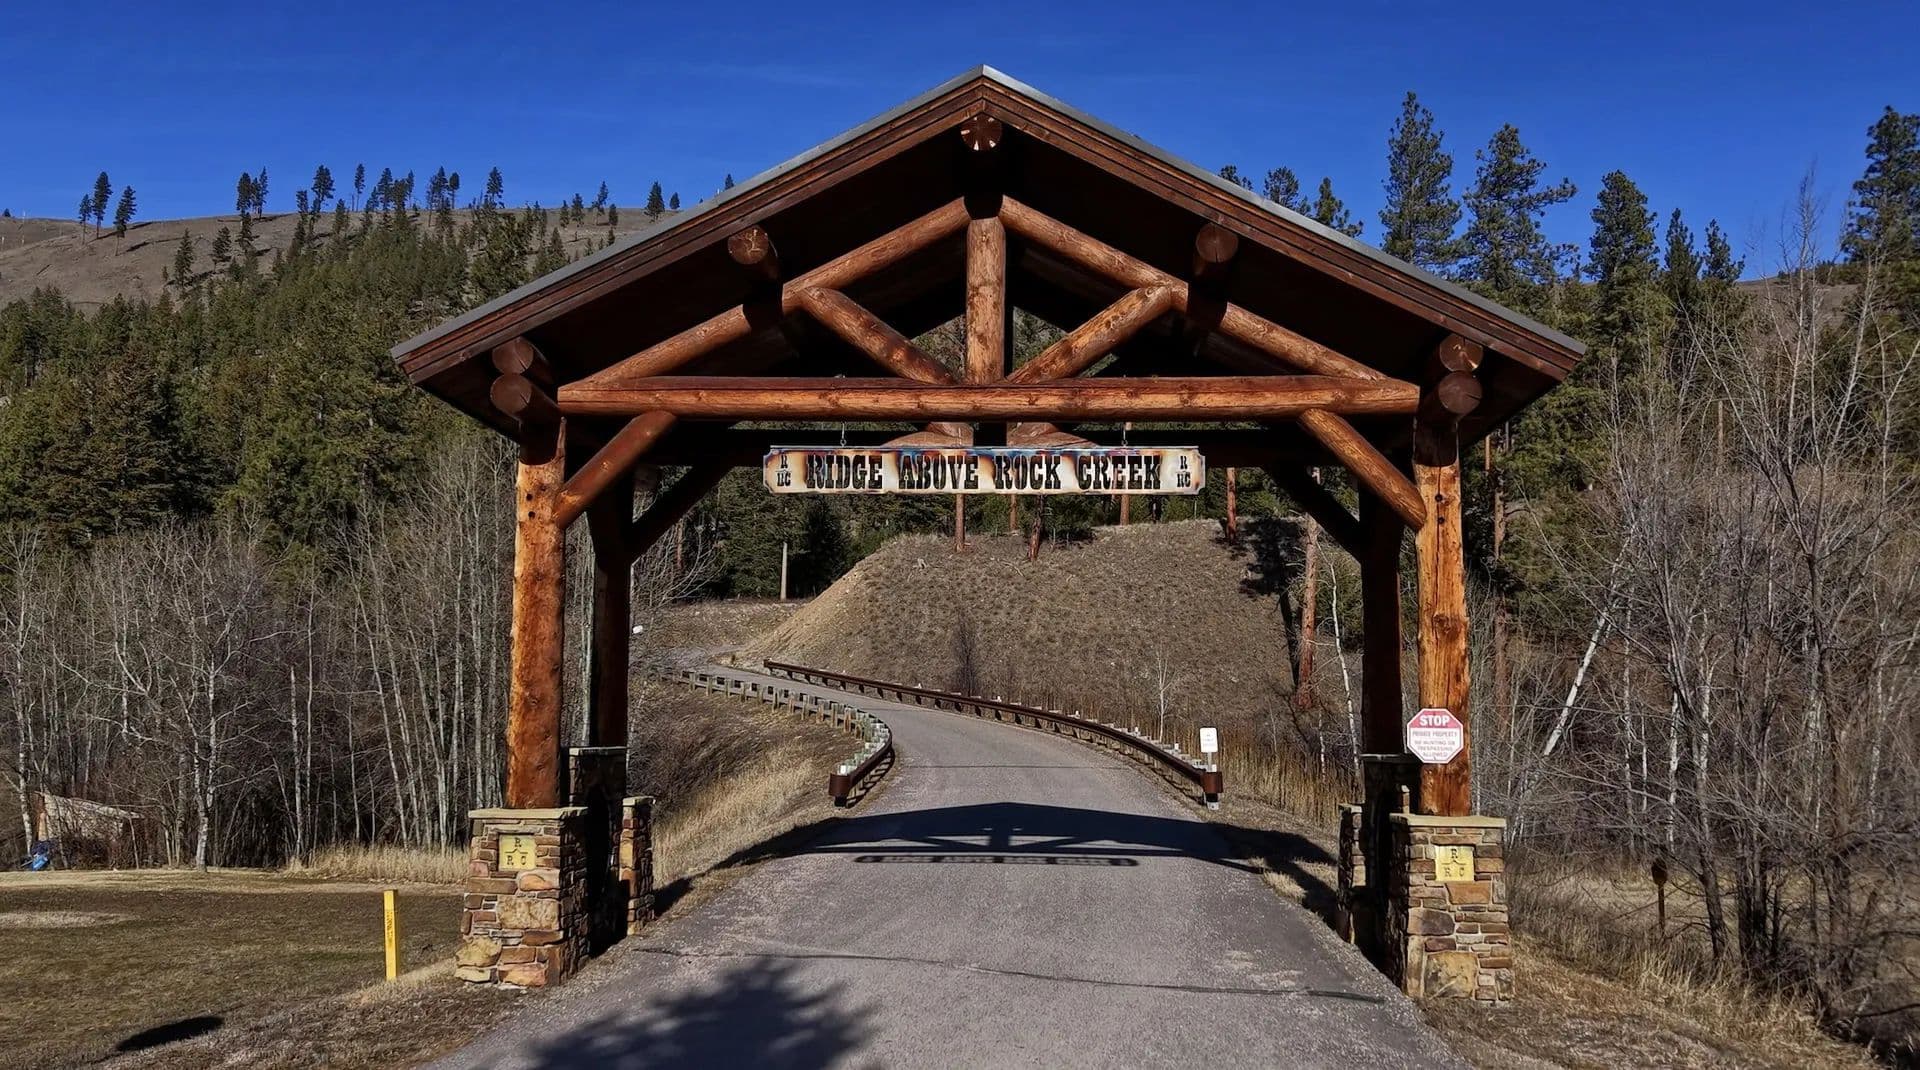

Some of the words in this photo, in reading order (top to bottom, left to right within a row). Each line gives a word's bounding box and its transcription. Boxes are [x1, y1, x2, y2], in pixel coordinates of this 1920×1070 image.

[780, 454, 789, 469] R
[1180, 455, 1188, 470] R
[806, 454, 883, 489] RIDGE
[899, 454, 979, 490] ABOVE
[994, 455, 1062, 490] ROCK
[1077, 455, 1161, 490] CREEK
[1419, 714, 1450, 727] STOP
[514, 836, 522, 848] R
[1451, 848, 1459, 859] R
